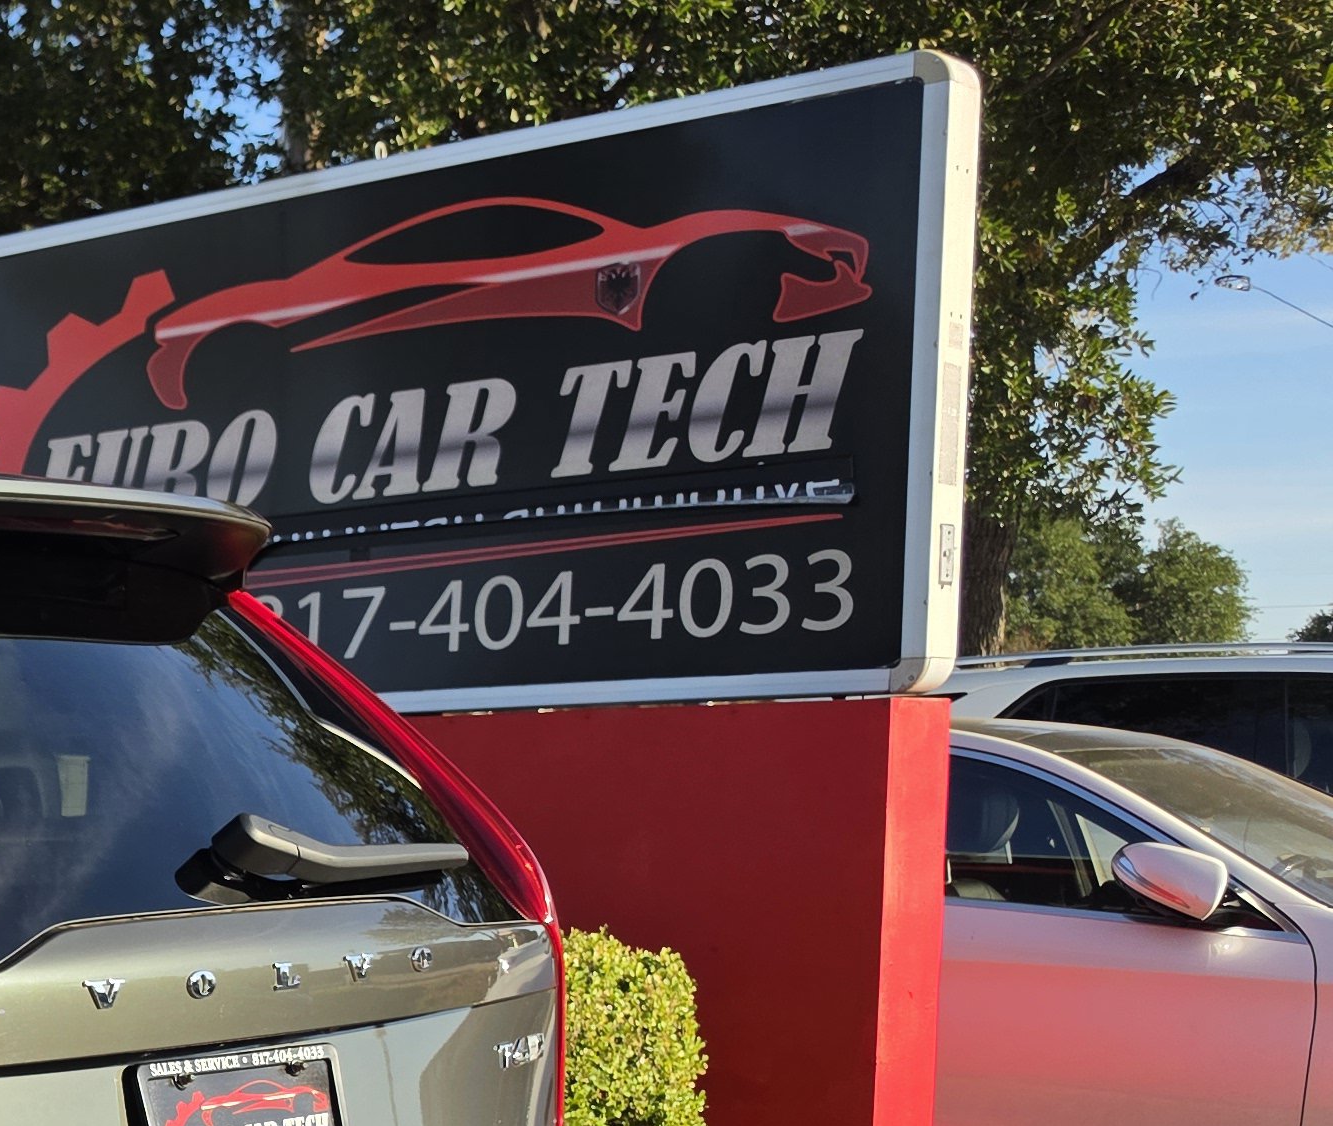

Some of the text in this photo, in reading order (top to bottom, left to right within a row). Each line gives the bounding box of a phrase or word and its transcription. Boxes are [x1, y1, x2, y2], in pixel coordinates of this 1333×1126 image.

[309, 376, 517, 505] CAR
[551, 329, 864, 480] TECH
[82, 945, 434, 1011] VOLVO
[150, 1061, 182, 1077] SALES
[194, 1054, 241, 1073] SERVICE
[251, 1046, 325, 1066] 817-404-4033
